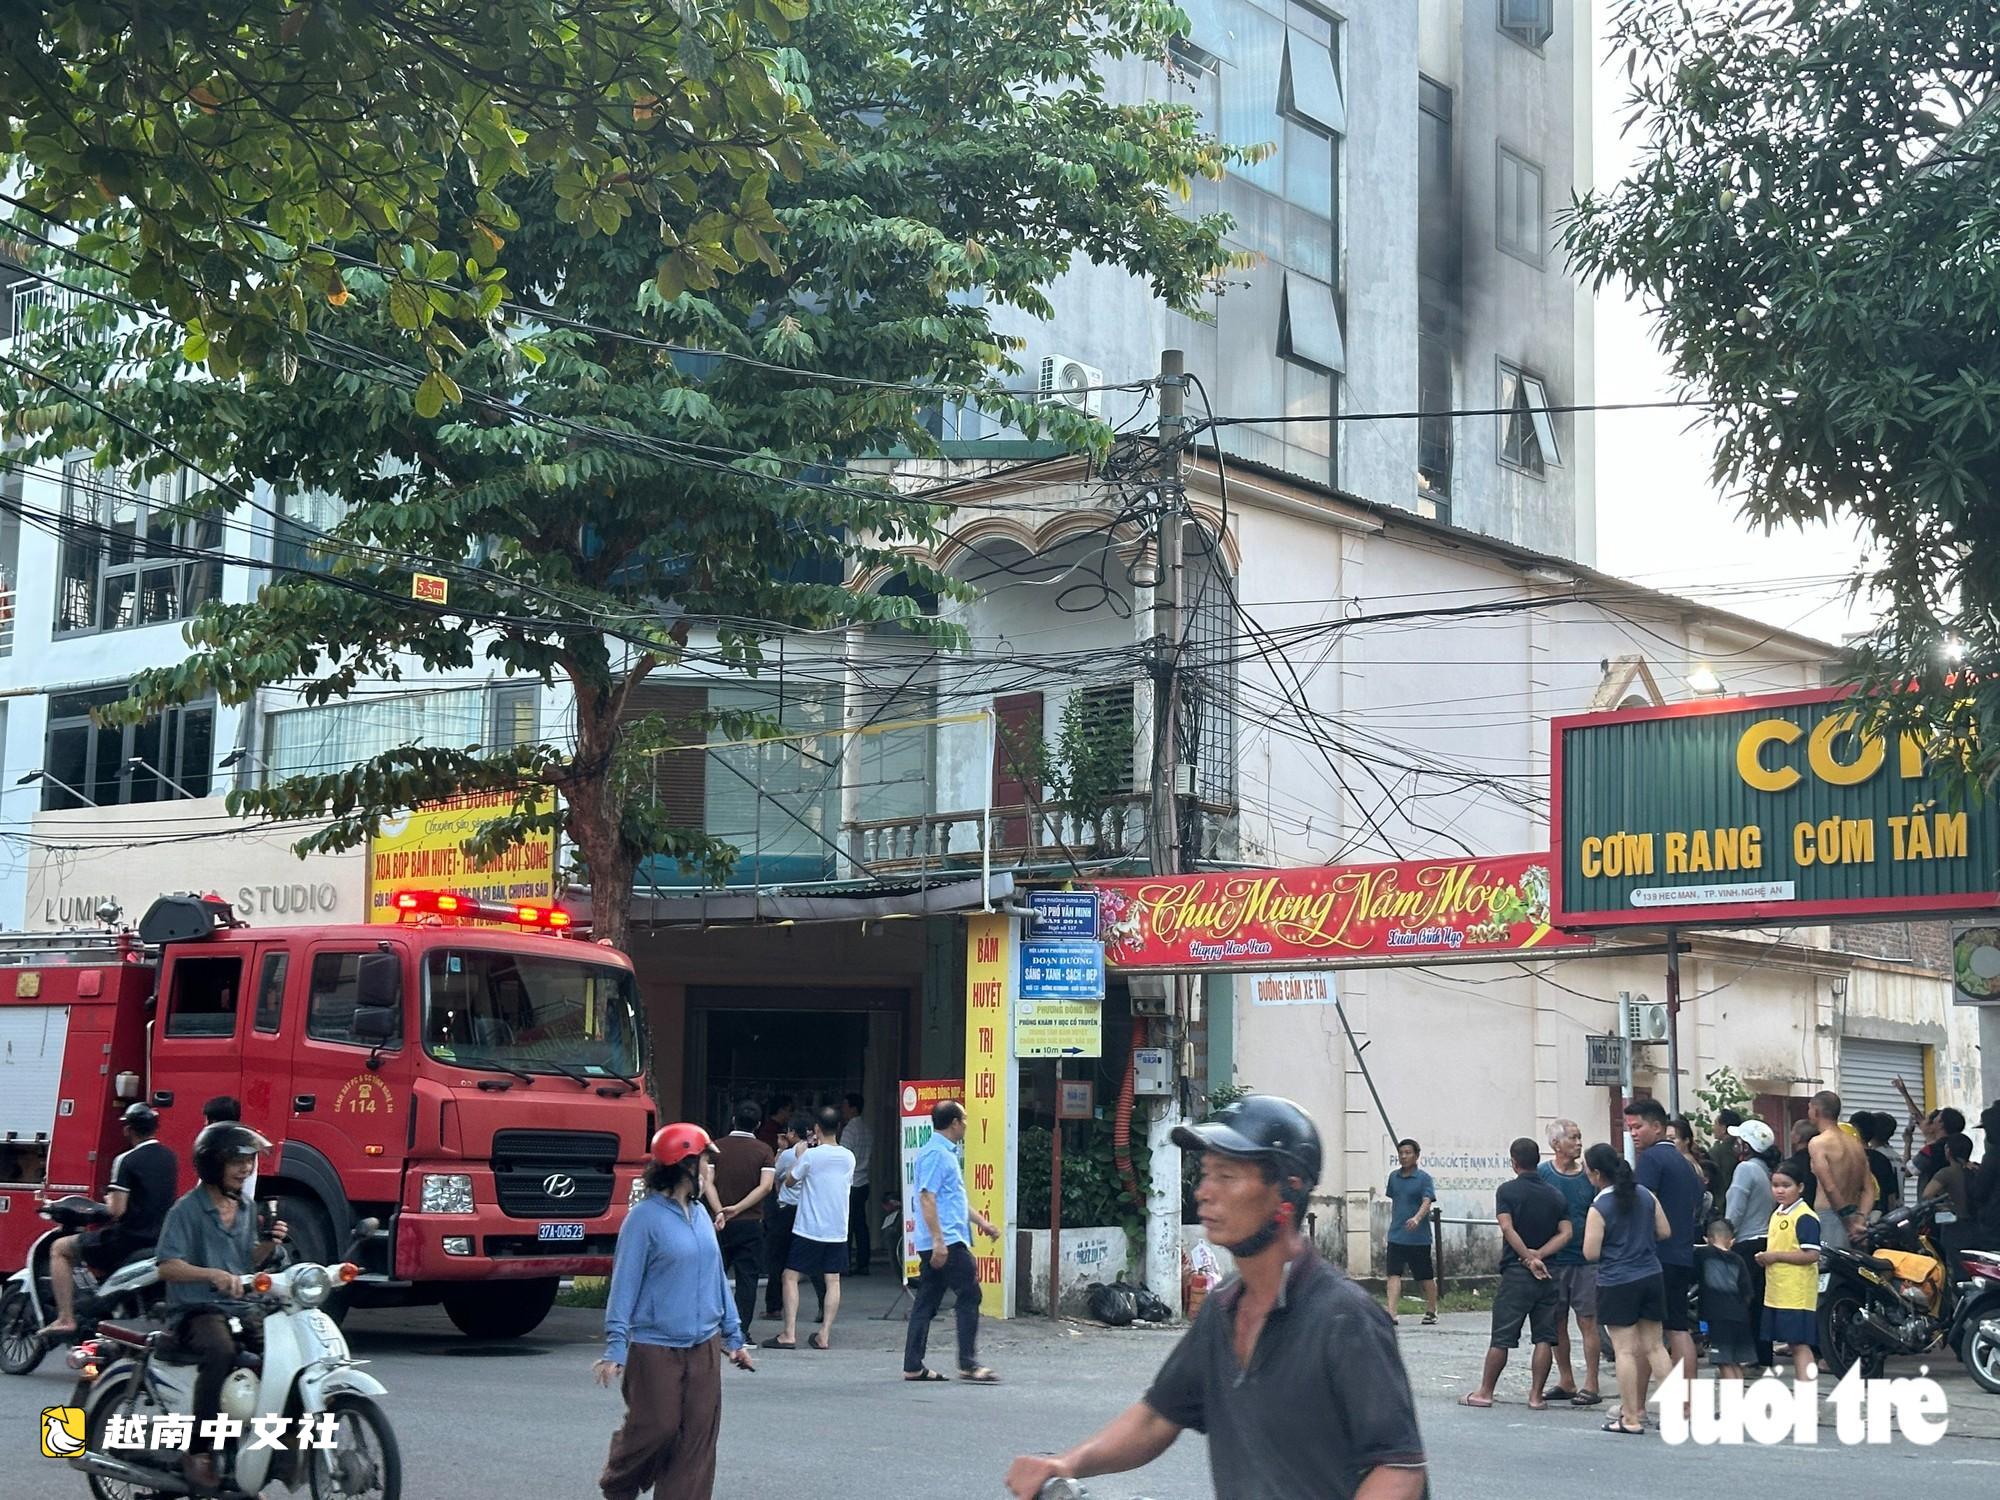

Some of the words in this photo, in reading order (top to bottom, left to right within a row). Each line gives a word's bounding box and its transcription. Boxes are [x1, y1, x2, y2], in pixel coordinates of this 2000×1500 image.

[1582, 831, 1654, 878] CƠM
[1665, 825, 1762, 875] RANG
[1793, 815, 1876, 867] CƠM
[1887, 799, 1968, 861] TẤM
[376, 853, 391, 880] XOA
[393, 845, 409, 879] BÓP
[411, 841, 430, 877] BẤM
[237, 882, 337, 915] STUDIO
[1138, 879, 1238, 943] Chúc
[1210, 876, 1340, 947] Mừng
[1318, 868, 1434, 948] Năm
[1402, 864, 1510, 928] Mới
[1643, 893, 1658, 901] 139
[1769, 885, 1782, 895] AN
[1048, 903, 1061, 917] PHỐ
[1062, 904, 1074, 917] VĂN
[977, 927, 999, 963] BẤM
[1189, 941, 1224, 960] Happy
[1224, 939, 1248, 956] New
[1247, 938, 1272, 954] Year
[1025, 966, 1041, 980] SÁNG
[1257, 974, 1283, 1001] ĐƯỜNG
[1284, 973, 1302, 1000] CẤM
[1303, 979, 1314, 1000] XE
[972, 976, 1002, 1014] HUYỆT
[979, 1027, 993, 1059] TRỊ
[1043, 1046, 1059, 1054] 10m
[975, 1067, 996, 1105] LIỆU
[349, 1099, 376, 1113] 114
[904, 1125, 918, 1149] XOA
[981, 1118, 988, 1144] Y
[1460, 1152, 1469, 1172] TỆ
[975, 1164, 994, 1196] HỌC
